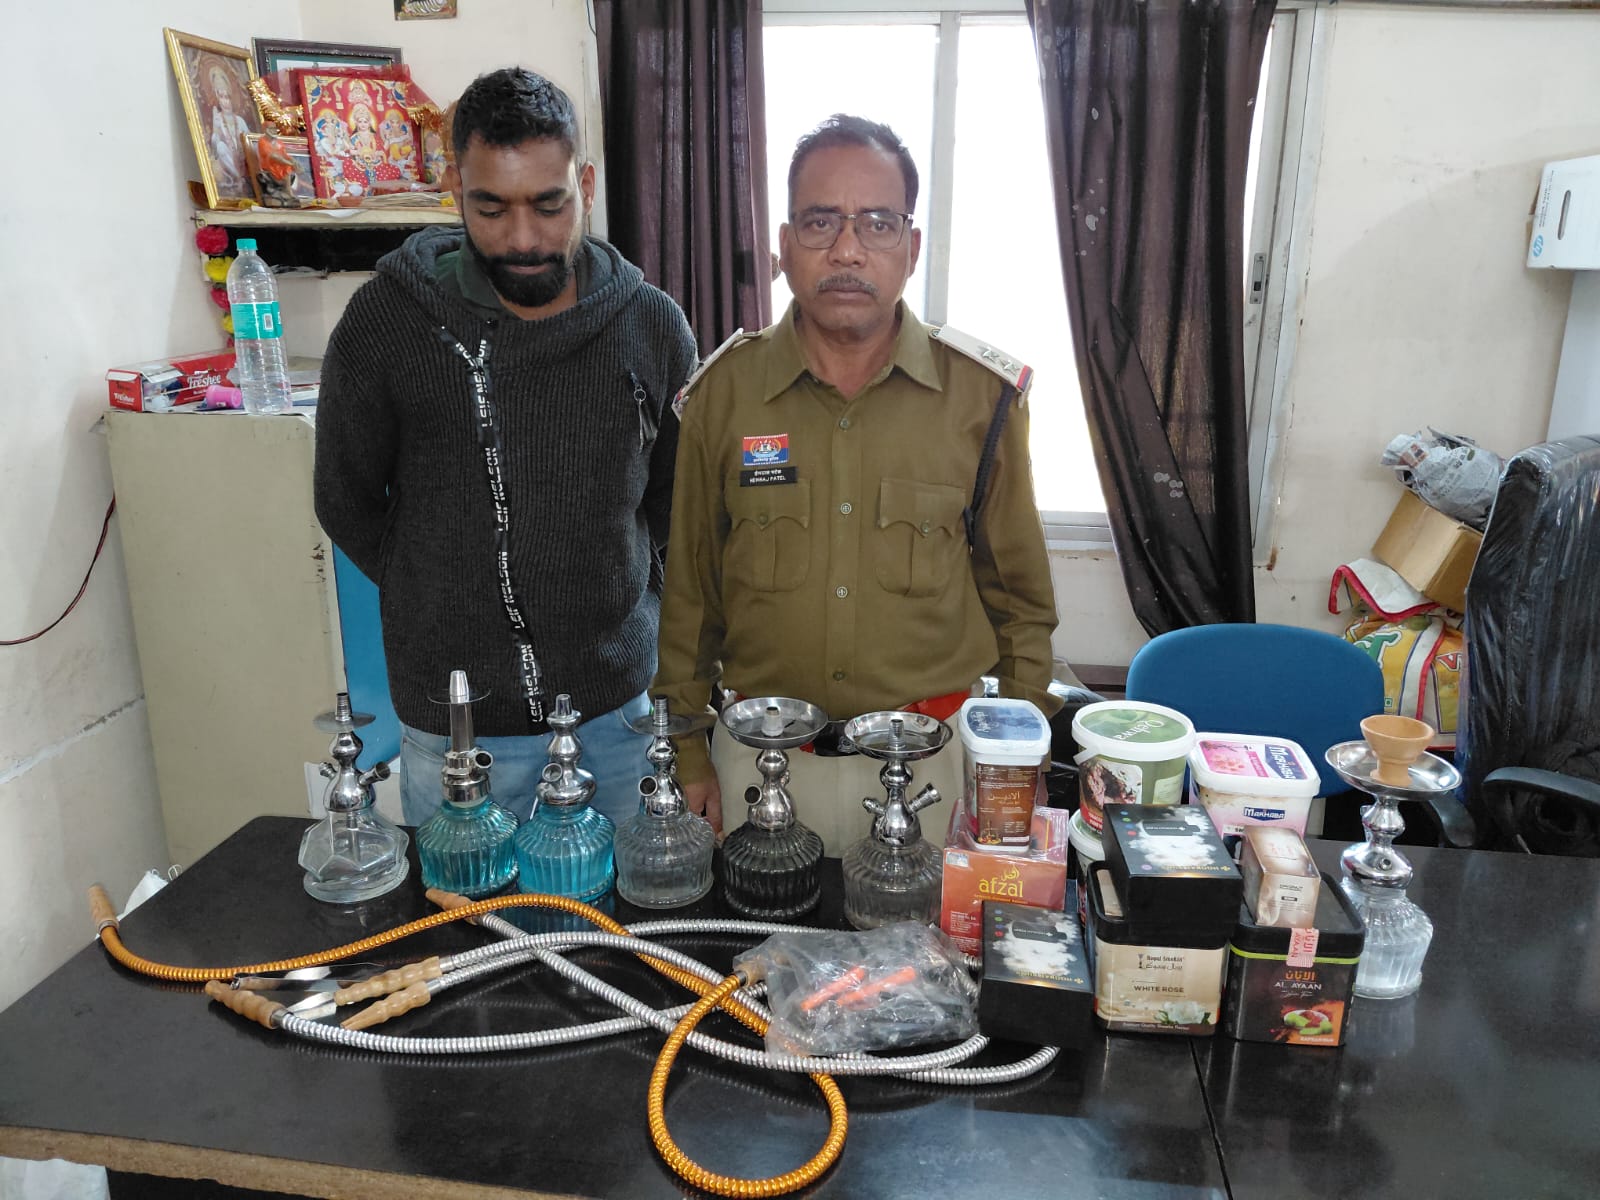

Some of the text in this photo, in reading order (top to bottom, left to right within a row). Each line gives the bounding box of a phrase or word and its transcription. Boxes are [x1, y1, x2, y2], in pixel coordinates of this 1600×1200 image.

[485, 447, 506, 500] NELSON
[499, 551, 515, 604] NELSON
[520, 644, 540, 696] NELSON
[978, 877, 1024, 898] afzal
[1133, 985, 1160, 993] WHITE
[1291, 982, 1322, 991] AYAAN
